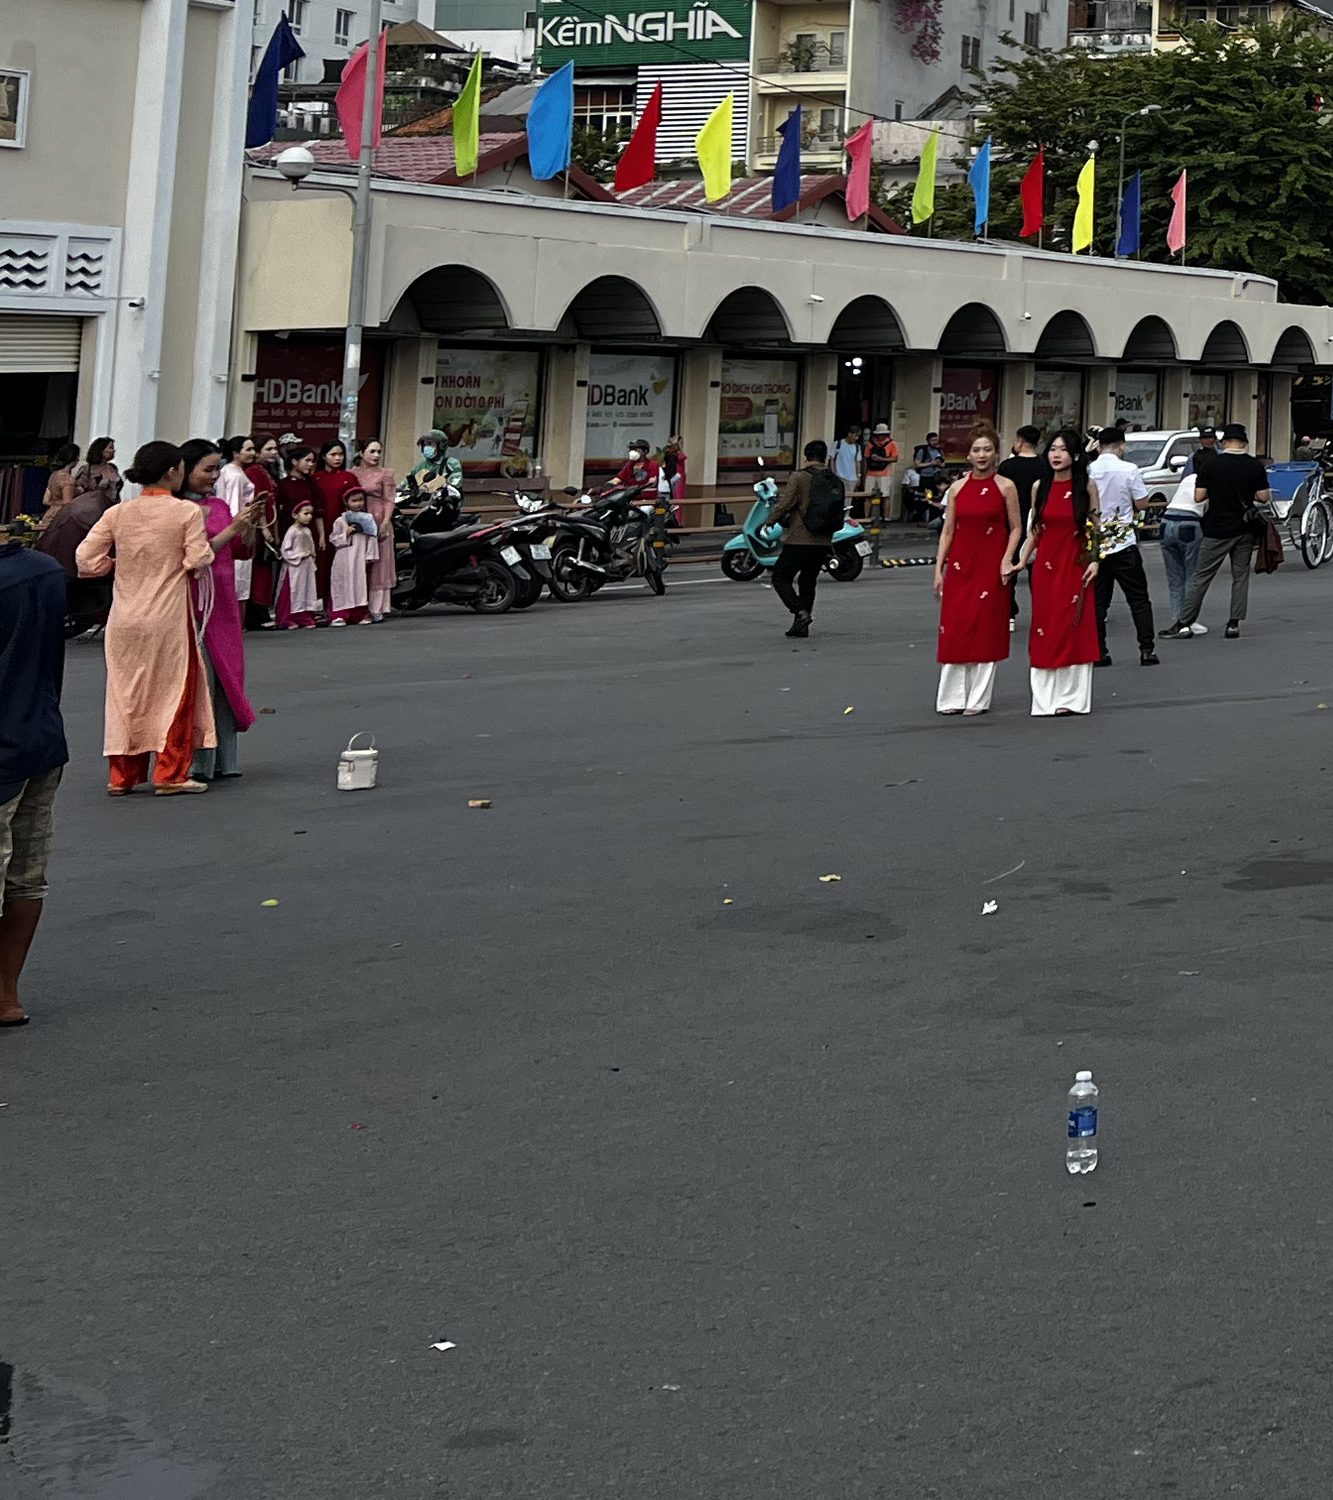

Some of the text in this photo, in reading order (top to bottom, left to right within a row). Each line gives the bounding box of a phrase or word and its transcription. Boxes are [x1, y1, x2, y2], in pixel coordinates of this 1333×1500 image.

[254, 379, 343, 404] HDBank
[940, 392, 978, 411] DBank
[1115, 395, 1144, 411] Bank
